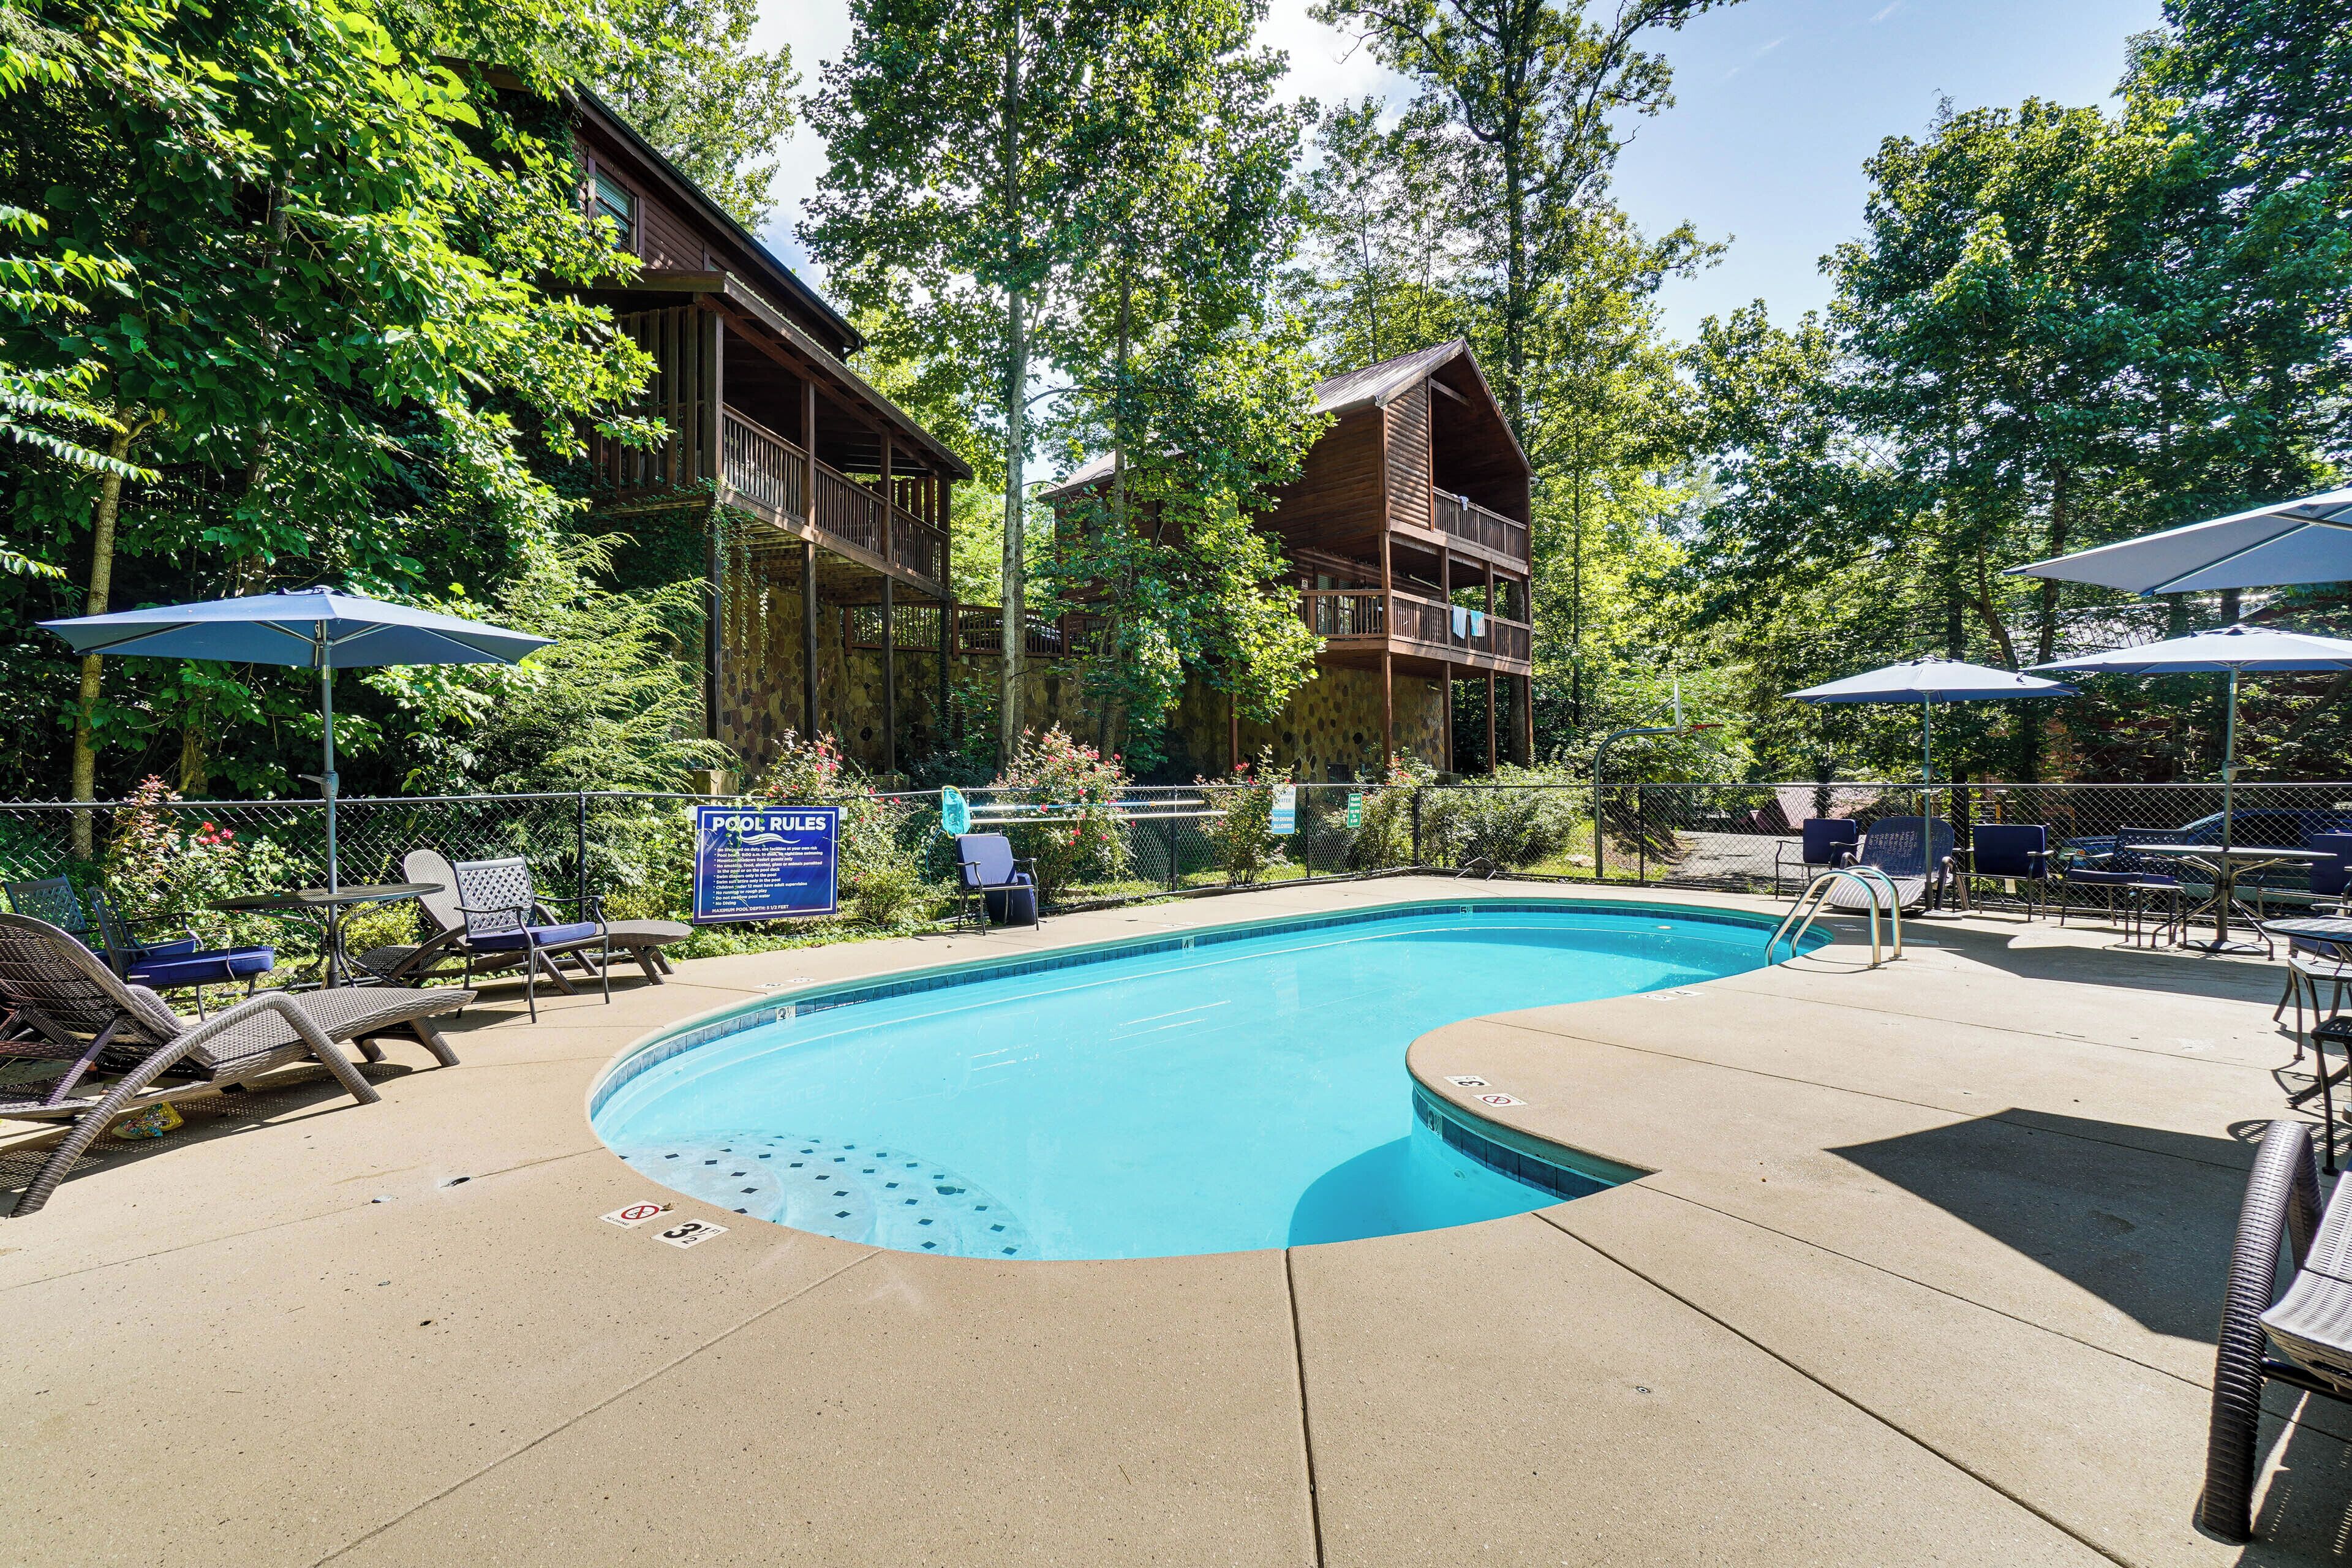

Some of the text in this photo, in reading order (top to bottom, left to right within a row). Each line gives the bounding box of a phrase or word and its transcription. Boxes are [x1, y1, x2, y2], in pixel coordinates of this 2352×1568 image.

[712, 816, 826, 831] POOL RULES
[1428, 1110, 1435, 1132] 3
[663, 1223, 702, 1239] 3
